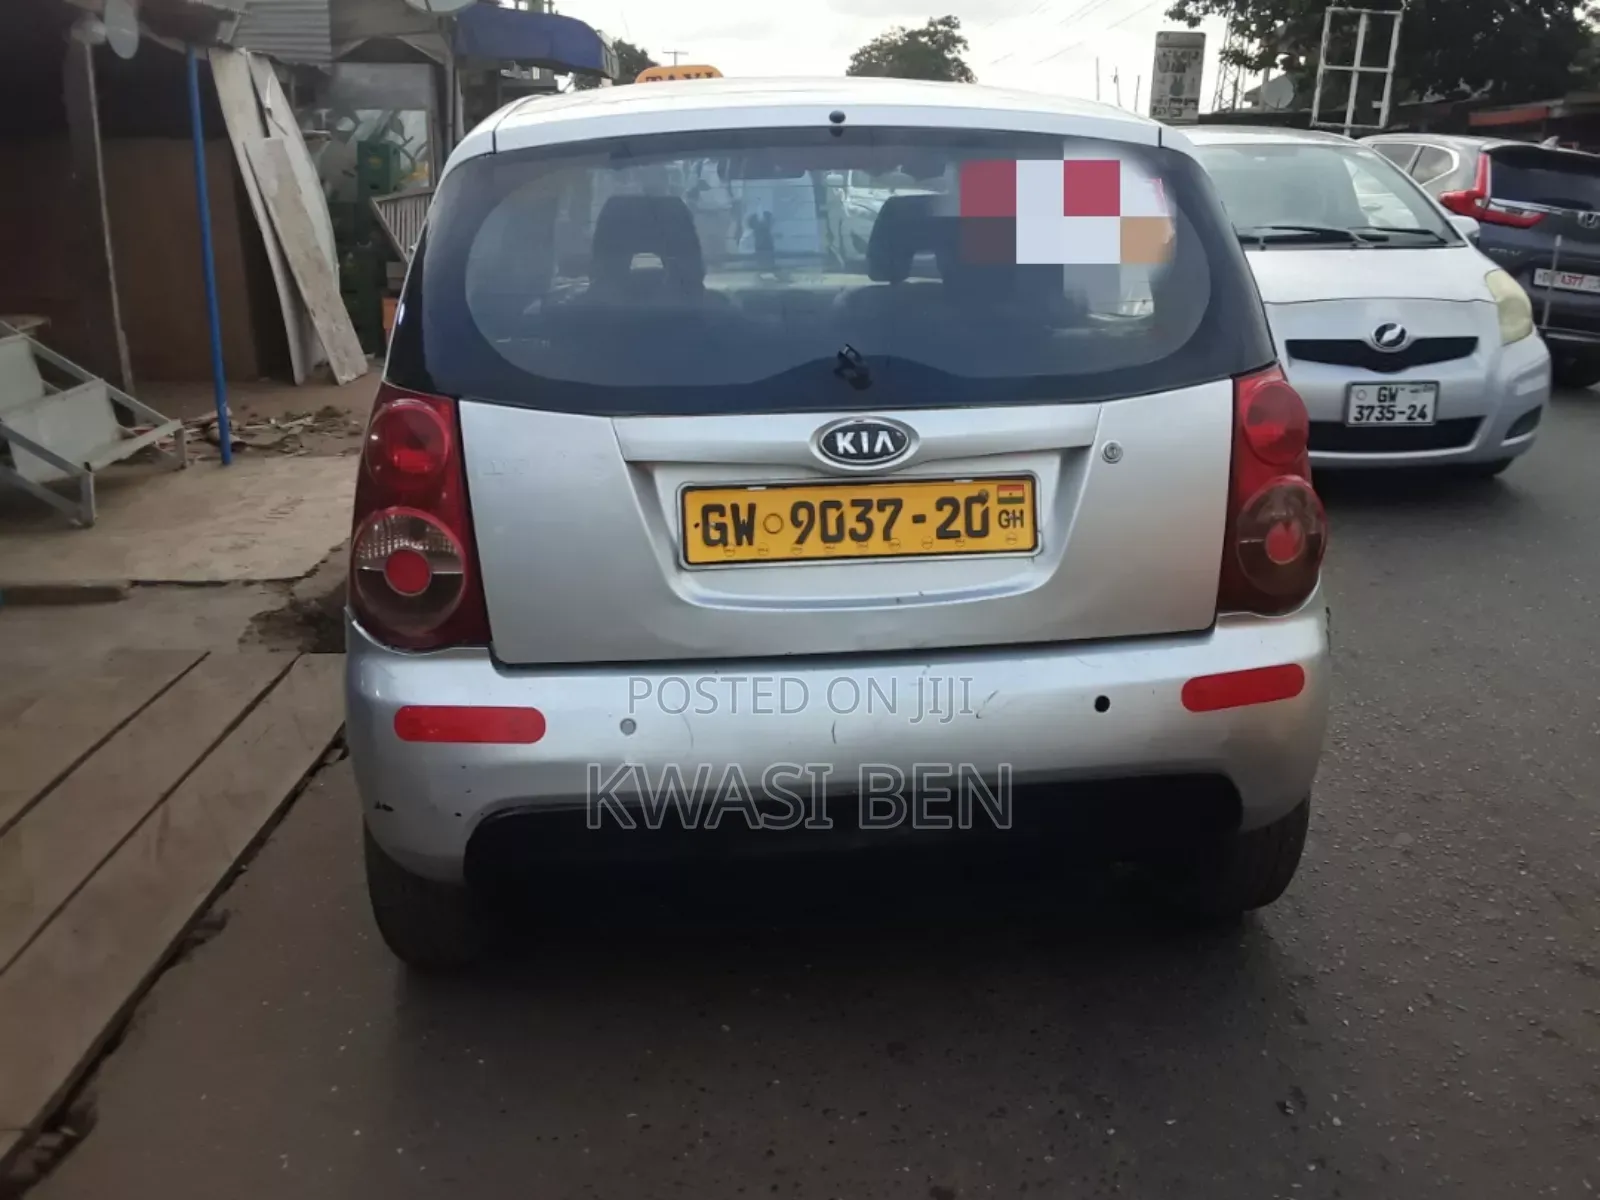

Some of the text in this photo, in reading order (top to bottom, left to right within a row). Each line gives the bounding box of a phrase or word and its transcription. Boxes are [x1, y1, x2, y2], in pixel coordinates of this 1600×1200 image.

[1377, 386, 1399, 403] GW
[1353, 404, 1427, 421] 3735-24
[836, 431, 896, 455] KIA
[701, 502, 756, 547] GW
[997, 508, 1025, 530] GH
